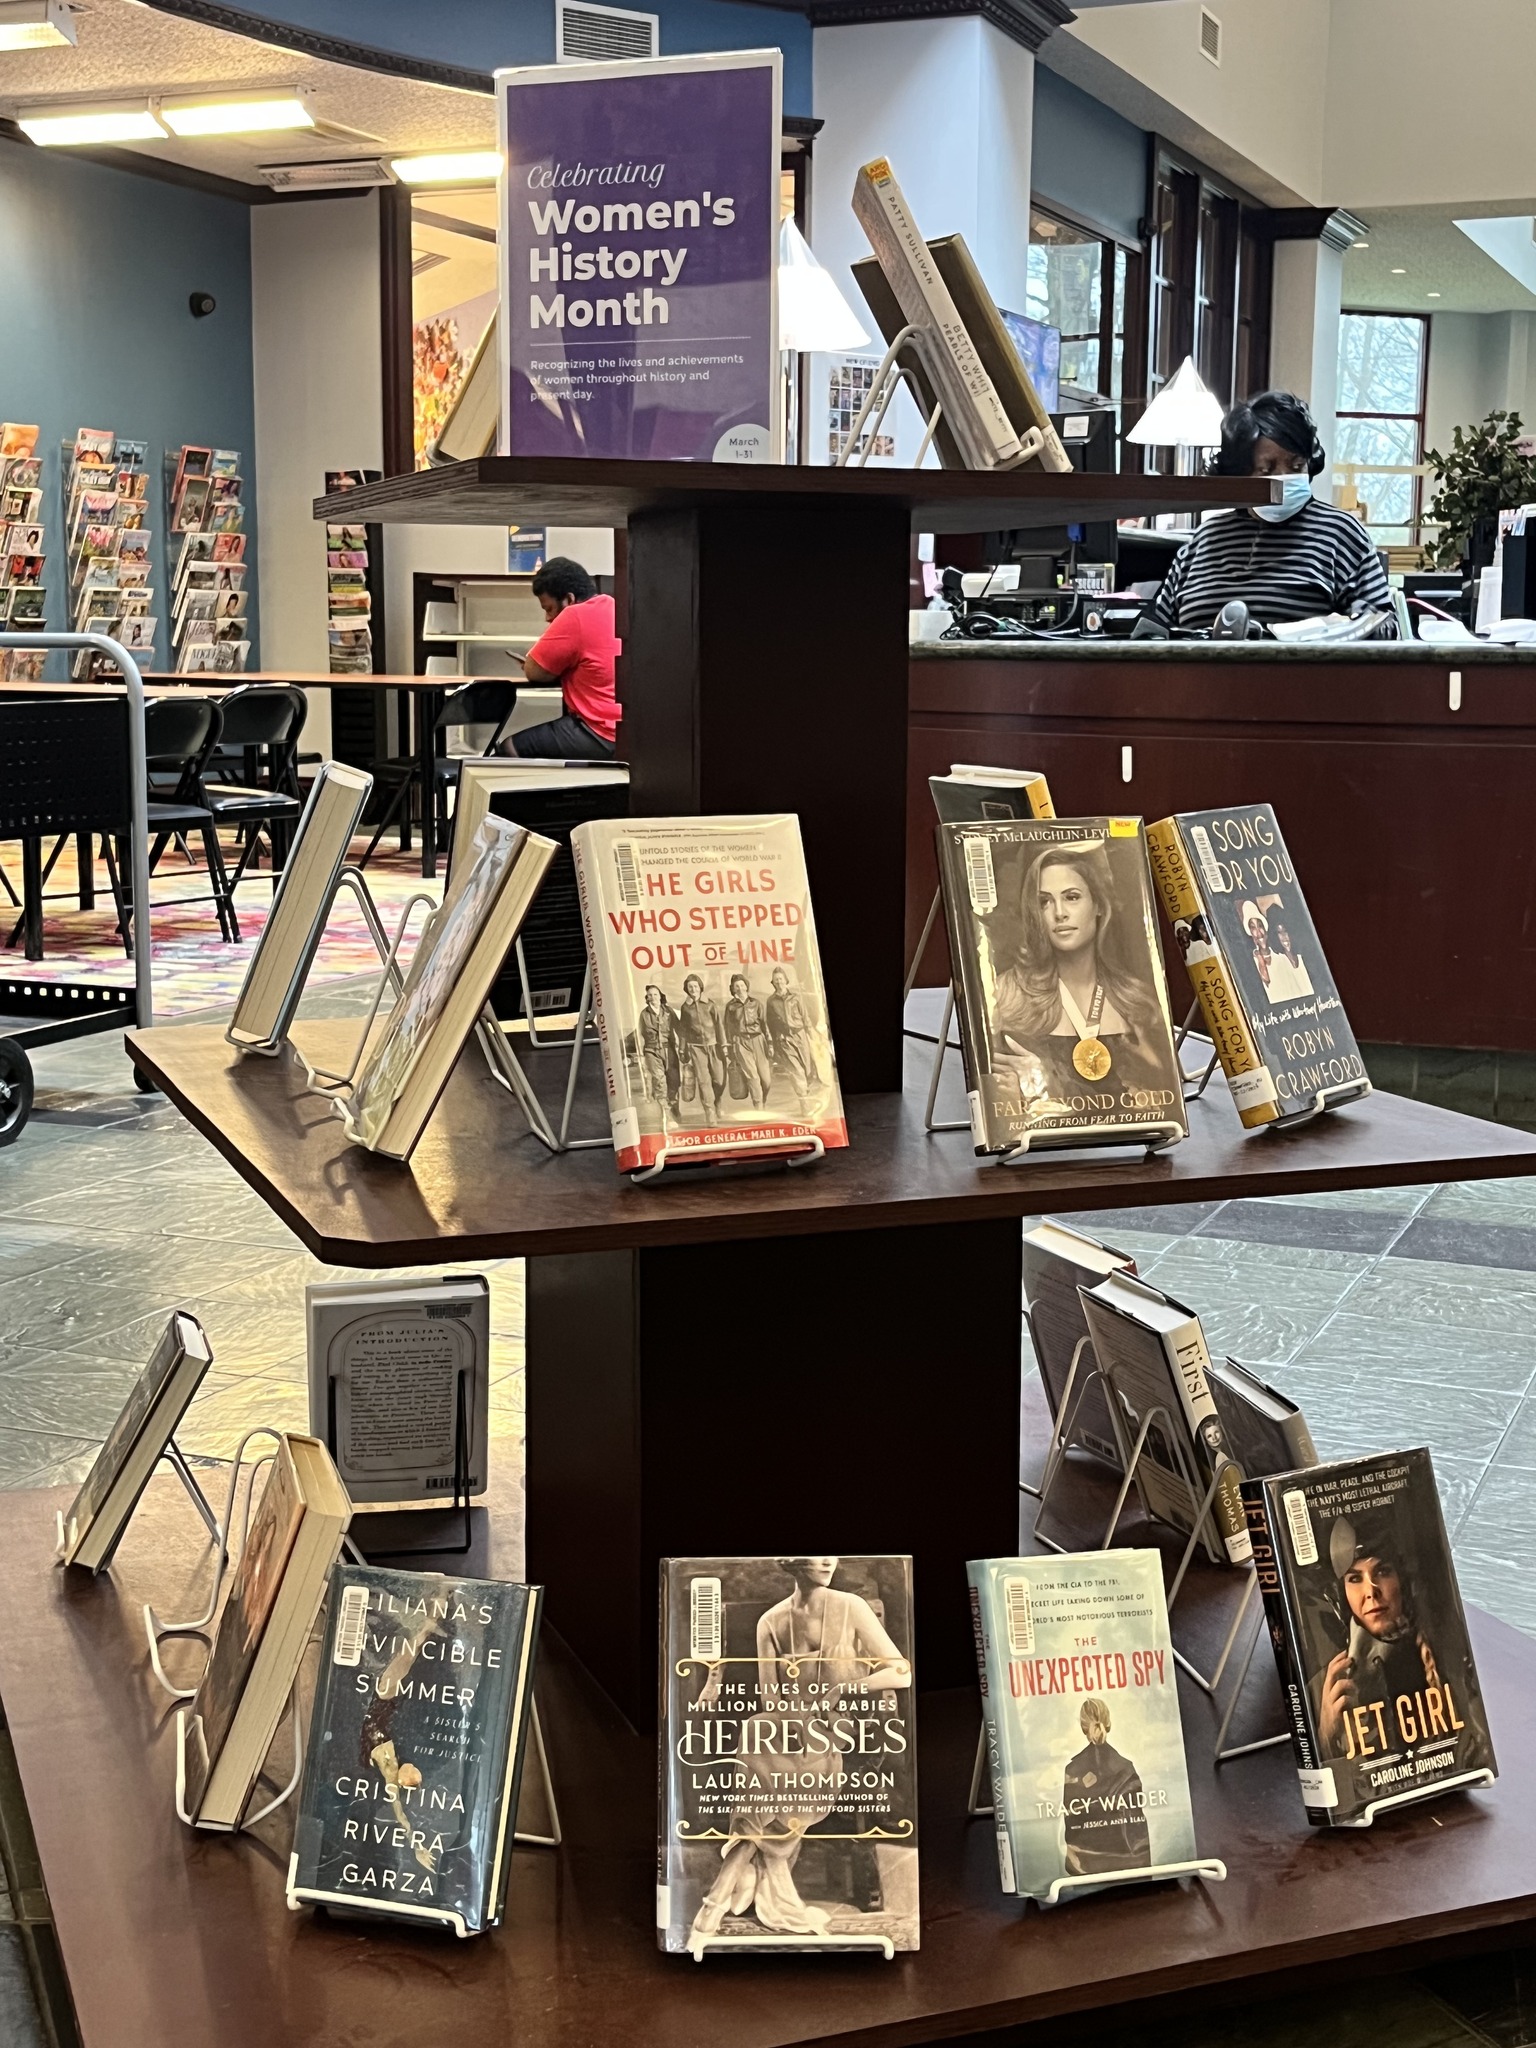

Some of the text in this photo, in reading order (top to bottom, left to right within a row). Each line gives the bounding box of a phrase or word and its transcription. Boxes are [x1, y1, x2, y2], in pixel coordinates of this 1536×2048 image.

[527, 161, 665, 189] Celebrating
[528, 191, 735, 235] Women's
[888, 196, 933, 285] PATTY SULLIVAN
[530, 242, 687, 285] History
[530, 288, 669, 328] Month
[952, 325, 975, 361] BETTY
[531, 354, 744, 371] Recognizing the lives and achievements
[543, 375, 583, 385] women
[586, 373, 647, 385] throughout
[650, 371, 686, 383] history
[689, 371, 710, 381] and
[962, 364, 971, 376] OF
[573, 389, 595, 401] day.
[729, 437, 759, 447] March
[735, 451, 753, 459] 1-31
[640, 846, 669, 855] UNTOLD
[670, 845, 699, 854] STORIES
[712, 844, 725, 852] THE
[727, 843, 756, 852] WOMEN
[1212, 816, 1273, 851] SONG
[641, 857, 674, 867] HANGED
[675, 857, 689, 865] THE
[731, 853, 759, 863] WORLD
[760, 853, 776, 861] WAR
[1147, 833, 1181, 913] CRAWFORD
[1164, 844, 1190, 892] ROBYN
[1245, 853, 1292, 888] YOU
[578, 870, 589, 910] GIRLS
[646, 872, 683, 898] HE
[694, 869, 776, 895] GIRLS
[585, 915, 595, 950] WHO
[608, 903, 803, 935] WHO STEPPED
[631, 938, 796, 970] OUT OF LINE
[589, 951, 603, 1008] STEPPED
[1205, 966, 1243, 1058] A SONG FOR
[599, 1013, 608, 1044] OUT
[1282, 1026, 1335, 1060] ROBYN
[606, 1064, 616, 1097] LINE
[1276, 1054, 1363, 1100] CRAWFORD
[992, 1102, 1029, 1118] FAR
[1120, 1089, 1175, 1109] GOLD
[1059, 1116, 1088, 1127] FROM
[1091, 1114, 1117, 1125] FEAR
[1118, 1113, 1132, 1122] TO
[1135, 1111, 1165, 1122] FAITH
[705, 1126, 817, 1144] GENERAL MARI K. EDER
[356, 1336, 448, 1344] INTRODUCTION
[1176, 1340, 1211, 1404] First
[1218, 1482, 1240, 1533] THOMAS
[1319, 1508, 1331, 1519] THE
[1352, 1500, 1372, 1512] SUPER
[1342, 1490, 1358, 1501] MOST
[1360, 1486, 1381, 1498] LETHAL
[1052, 1599, 1064, 1607] LIFE
[1092, 1595, 1114, 1604] DOWN
[1116, 1594, 1134, 1602] SOME
[1056, 1609, 1153, 1622] MOST NOTORIOUS TERRORISTS
[1074, 1636, 1098, 1647] THE
[715, 1682, 869, 1695] THE LIVES OF THE
[1008, 1650, 1165, 1698] UNEXPECTED SPY
[355, 1674, 475, 1707] SUMMER
[688, 1699, 897, 1713] MILLION DOLLAR BABIES
[1288, 1684, 1306, 1735] CAROLINE
[1342, 1683, 1465, 1760] JET GIRL
[677, 1718, 907, 1767] HEIRESSES
[986, 1719, 1001, 1770] TRACY
[692, 1771, 895, 1790] LAURA THOMPSON
[1370, 1764, 1414, 1788] CAROLINE
[1416, 1751, 1455, 1773] JOHNSON
[335, 1776, 466, 1814] CRISTINA
[698, 1805, 714, 1814] THE
[736, 1805, 752, 1813] THE
[755, 1805, 780, 1813] LIVES
[781, 1805, 794, 1813] OF
[797, 1805, 814, 1813] THE
[816, 1804, 855, 1813] MITFORD
[857, 1804, 891, 1813] SISTERS
[700, 1793, 889, 1802] NEW YORK TIMES BESTSELLING AUTHOR OF
[993, 1776, 1007, 1832] WALDE
[1036, 1789, 1169, 1819] TRACY WALDER
[343, 1819, 444, 1854] RIVERA
[1083, 1820, 1108, 1830] JESSICA
[342, 1863, 434, 1896] GARZA
